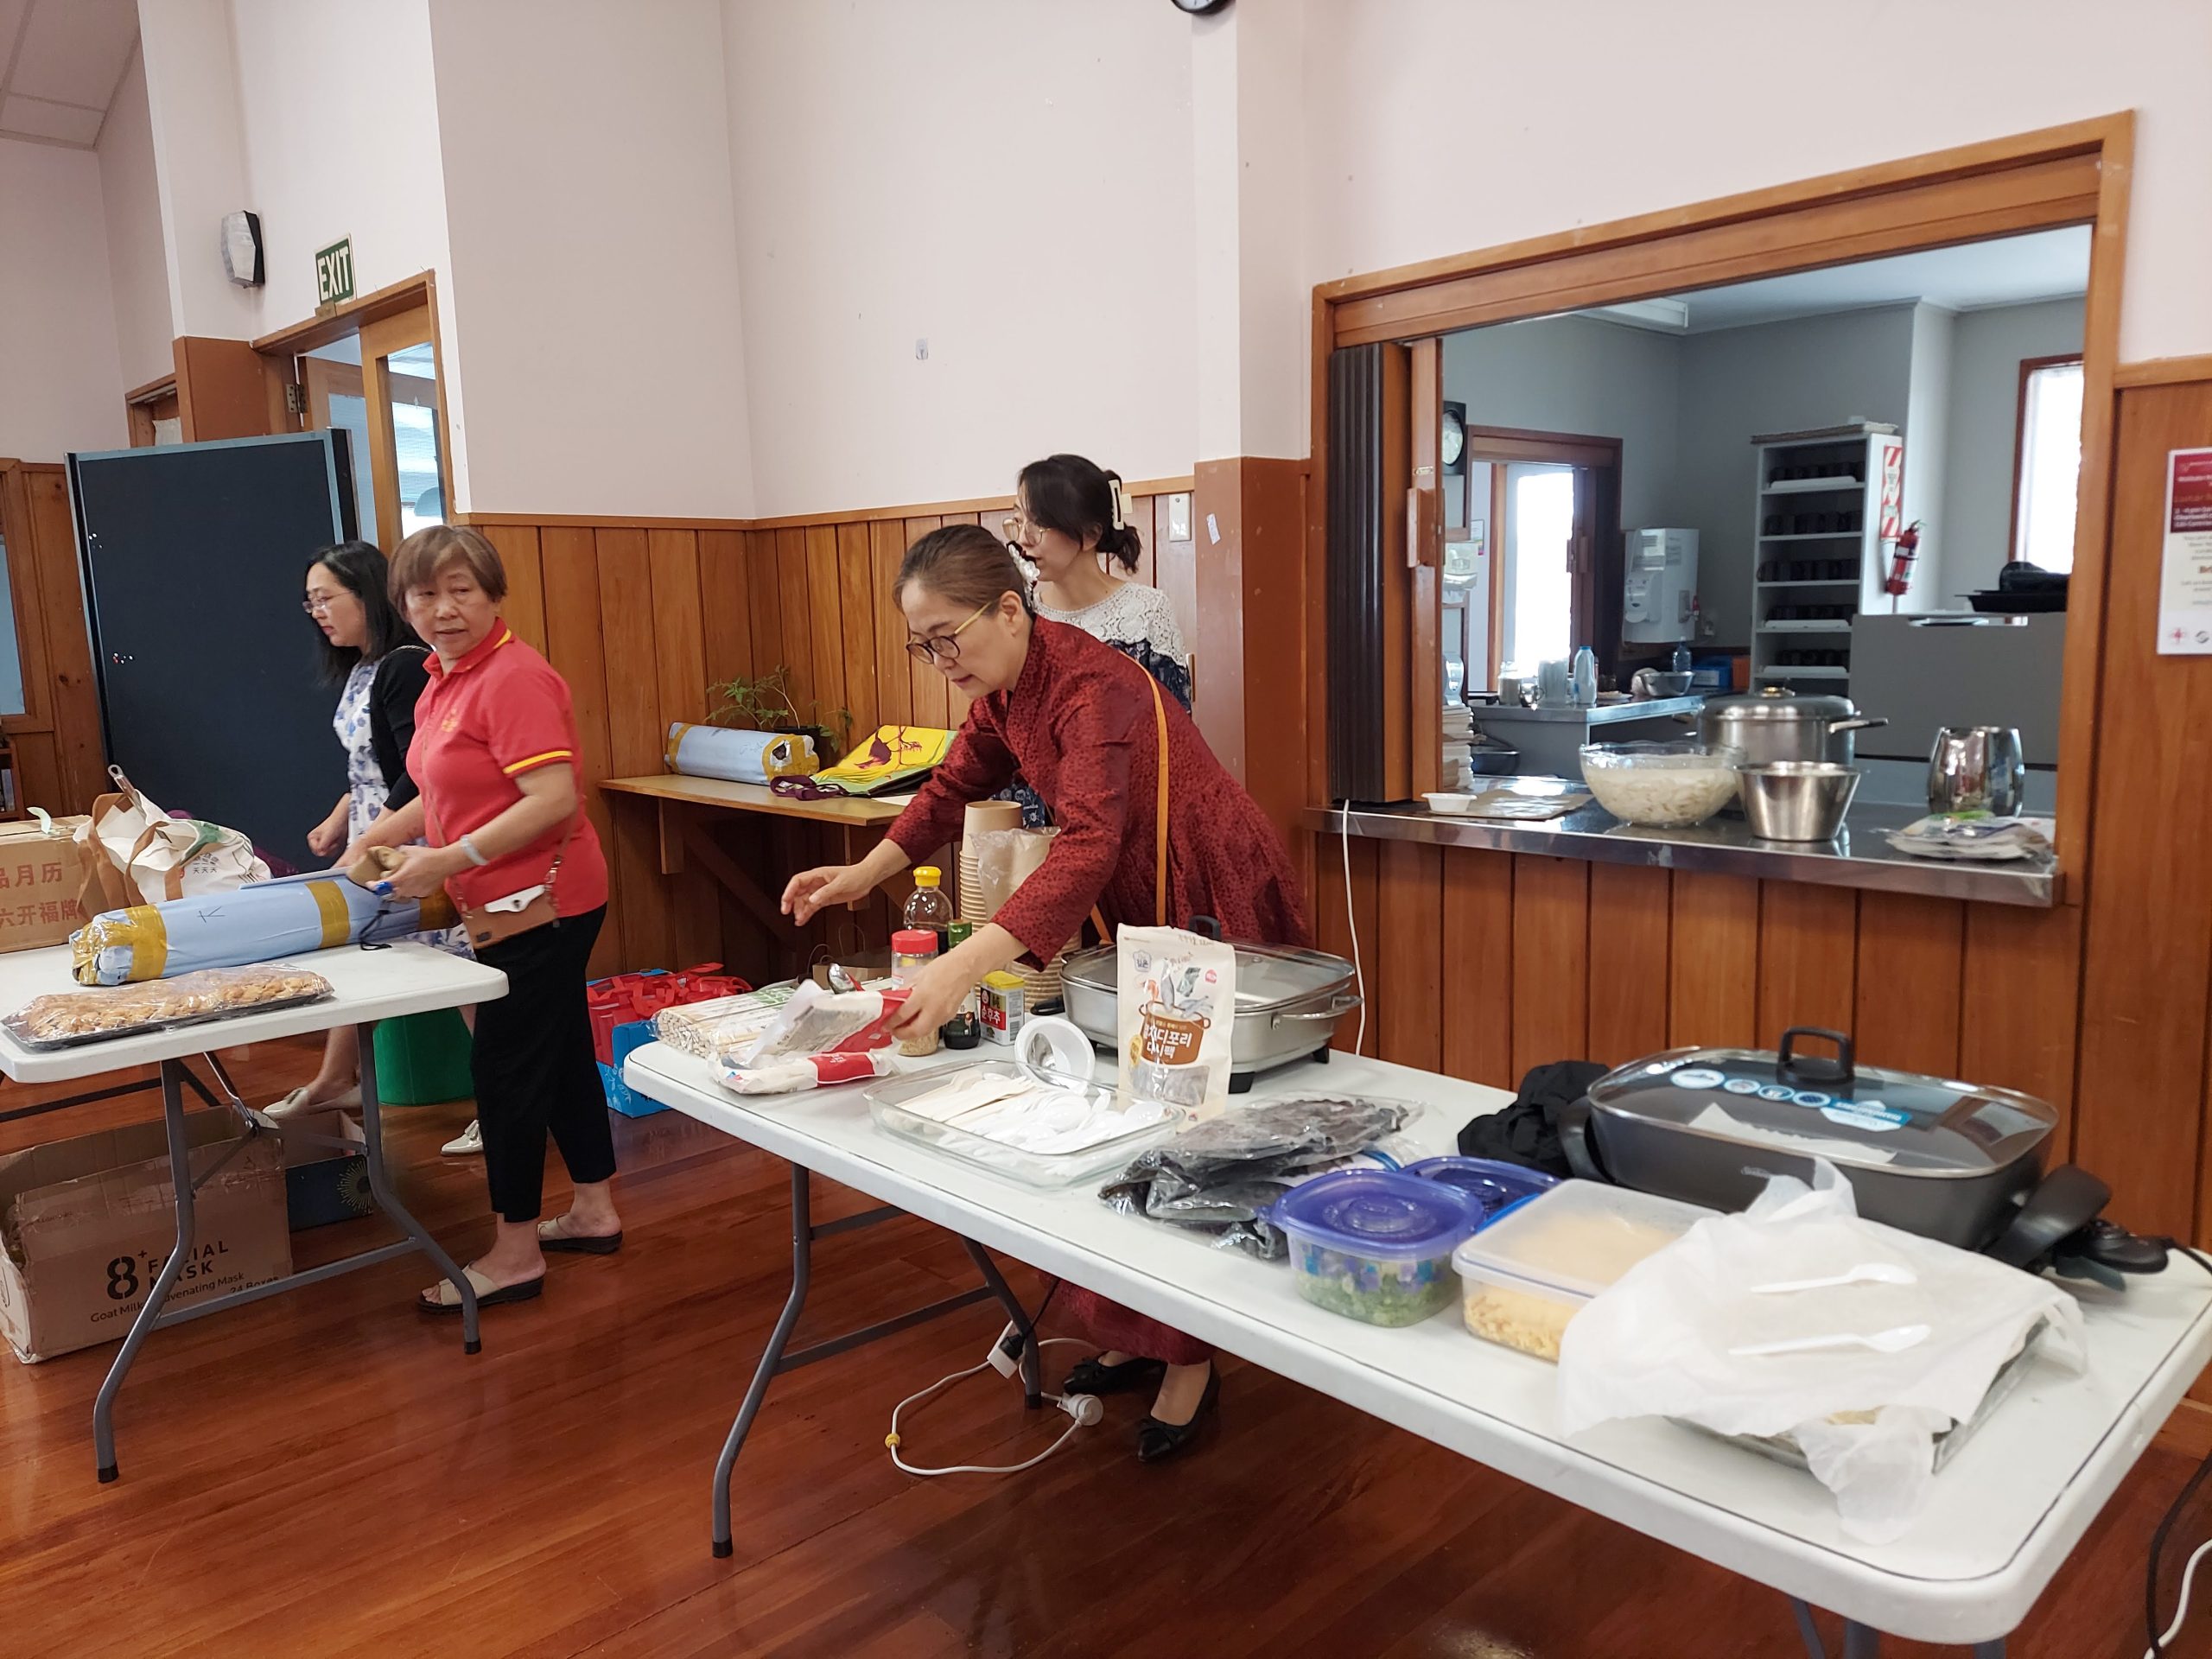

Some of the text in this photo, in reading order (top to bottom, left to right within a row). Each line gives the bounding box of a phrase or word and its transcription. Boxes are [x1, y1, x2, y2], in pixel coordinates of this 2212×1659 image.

[317, 245, 350, 300] EXIT
[982, 1005, 1001, 1025] 순후추
[148, 1241, 229, 1274] FIAL
[149, 1259, 213, 1291] MSK
[90, 1271, 245, 1323] Goat Milk uvenating Mask
